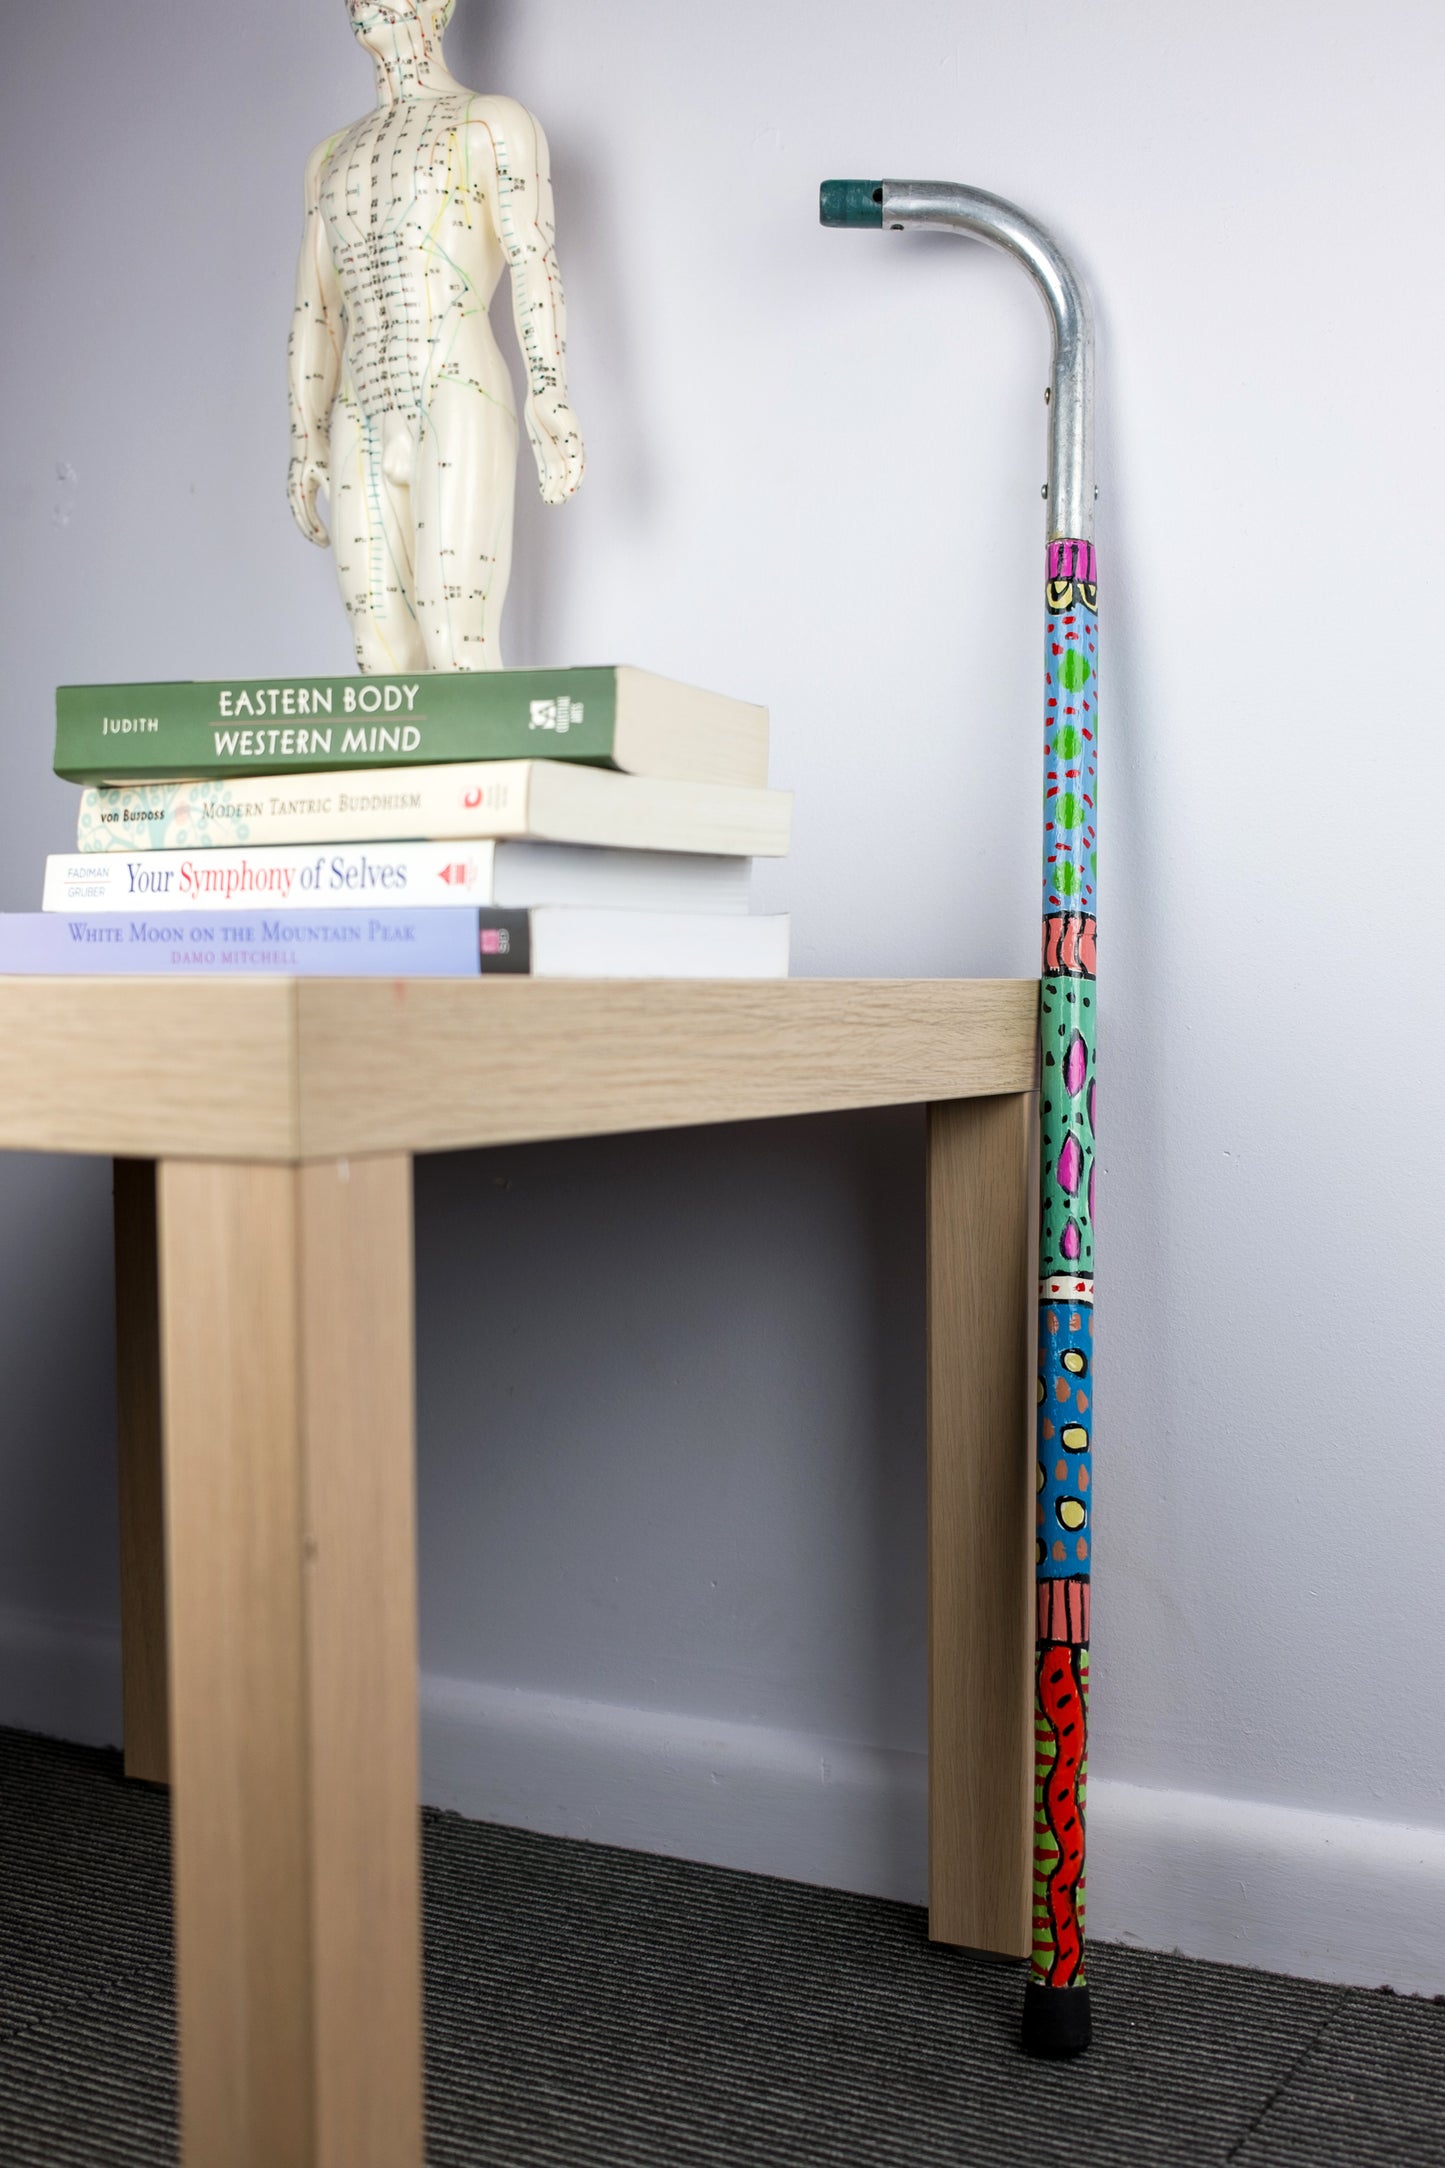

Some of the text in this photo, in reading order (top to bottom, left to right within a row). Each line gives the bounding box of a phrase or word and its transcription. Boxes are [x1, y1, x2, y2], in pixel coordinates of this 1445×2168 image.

[219, 684, 419, 717] EASTERN BODY
[102, 718, 159, 735] JUDITH
[214, 726, 421, 757] WESTERN MIND
[203, 793, 421, 820] MODERN TANTRIC BUDDHISM
[100, 813, 119, 823] von
[67, 867, 110, 879] FADIMAN
[127, 856, 408, 899] Your Symphony of Selves
[68, 887, 106, 898] GRUBER
[68, 920, 416, 943] WHITE MOON ON THE MOUNTAIN PEAK
[171, 951, 298, 965] DAMO MITCHELL
